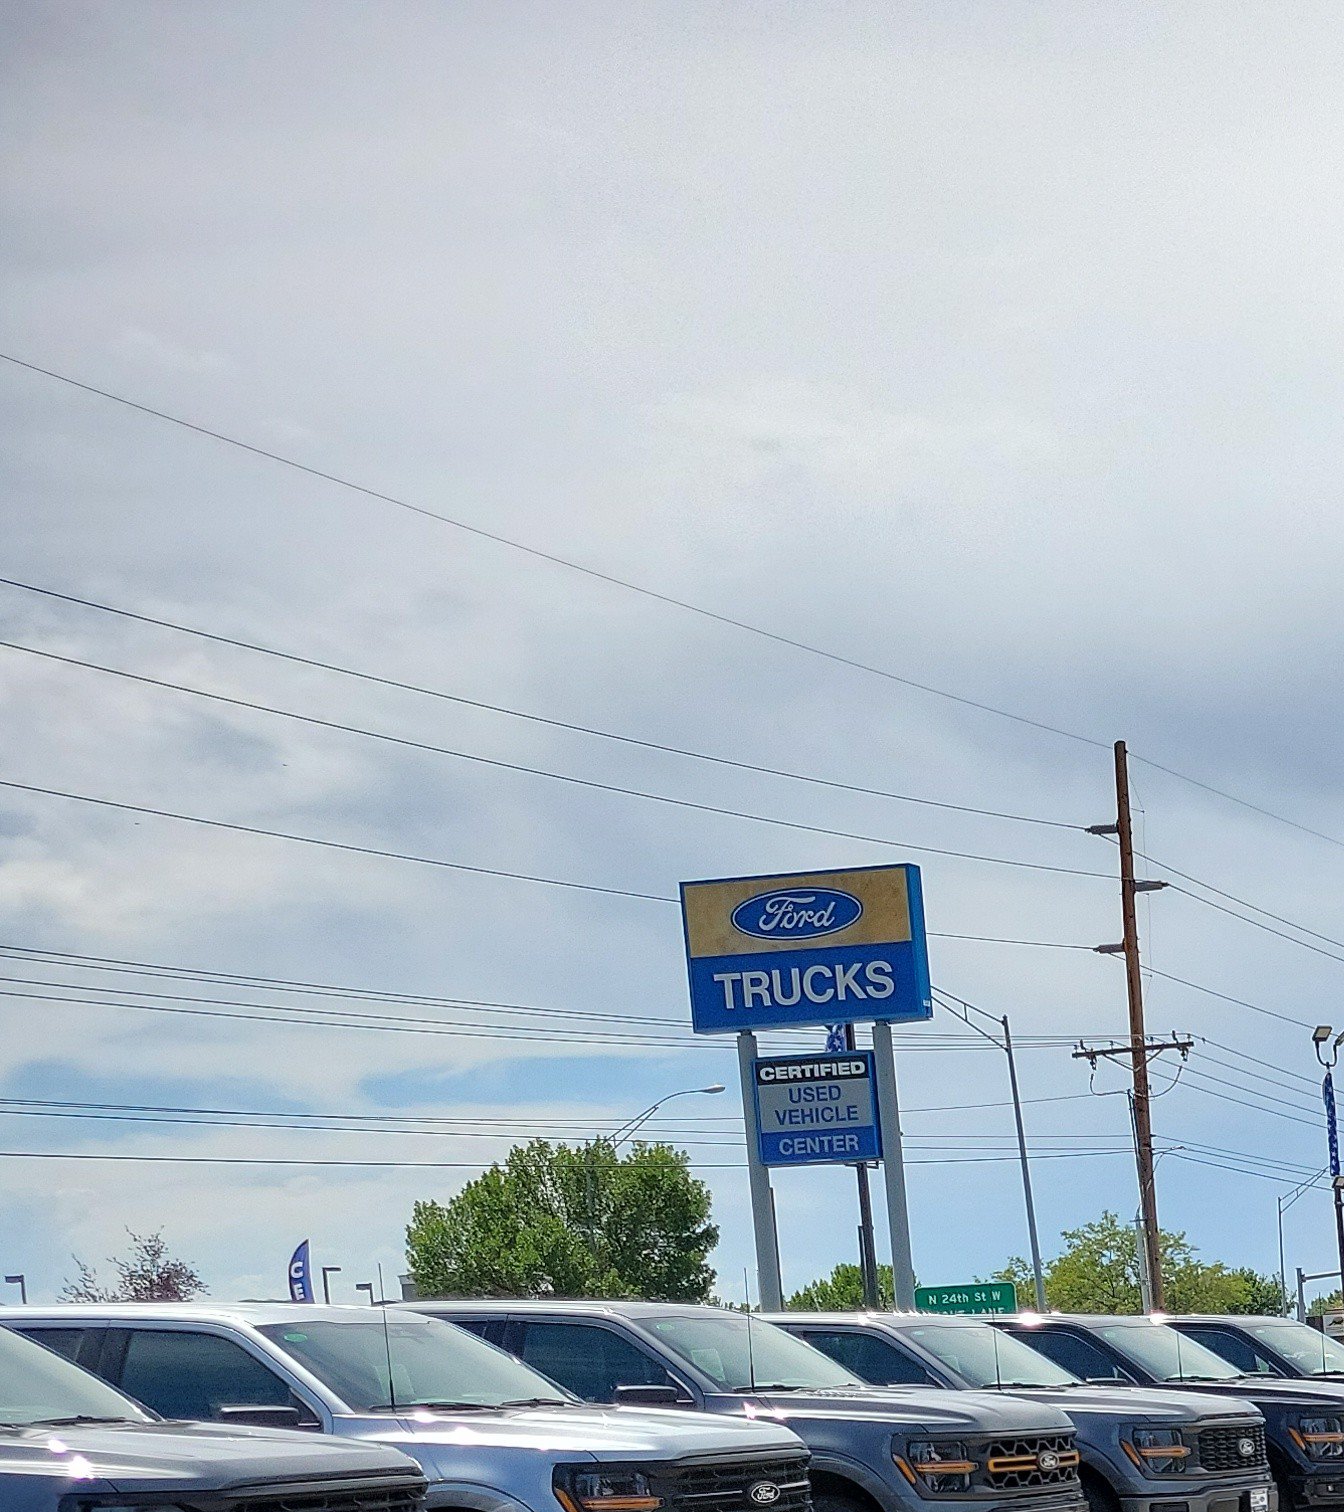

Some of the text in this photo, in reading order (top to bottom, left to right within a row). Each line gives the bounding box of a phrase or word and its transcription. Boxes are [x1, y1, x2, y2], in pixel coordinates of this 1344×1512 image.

[758, 896, 836, 931] Ford
[713, 960, 895, 1009] TRUCKS
[759, 1060, 866, 1081] CERTIFIED
[788, 1084, 842, 1104] USED
[774, 1105, 860, 1126] VEHICLE
[778, 1134, 860, 1155] CENTER
[928, 1290, 1001, 1305] N 24th St W
